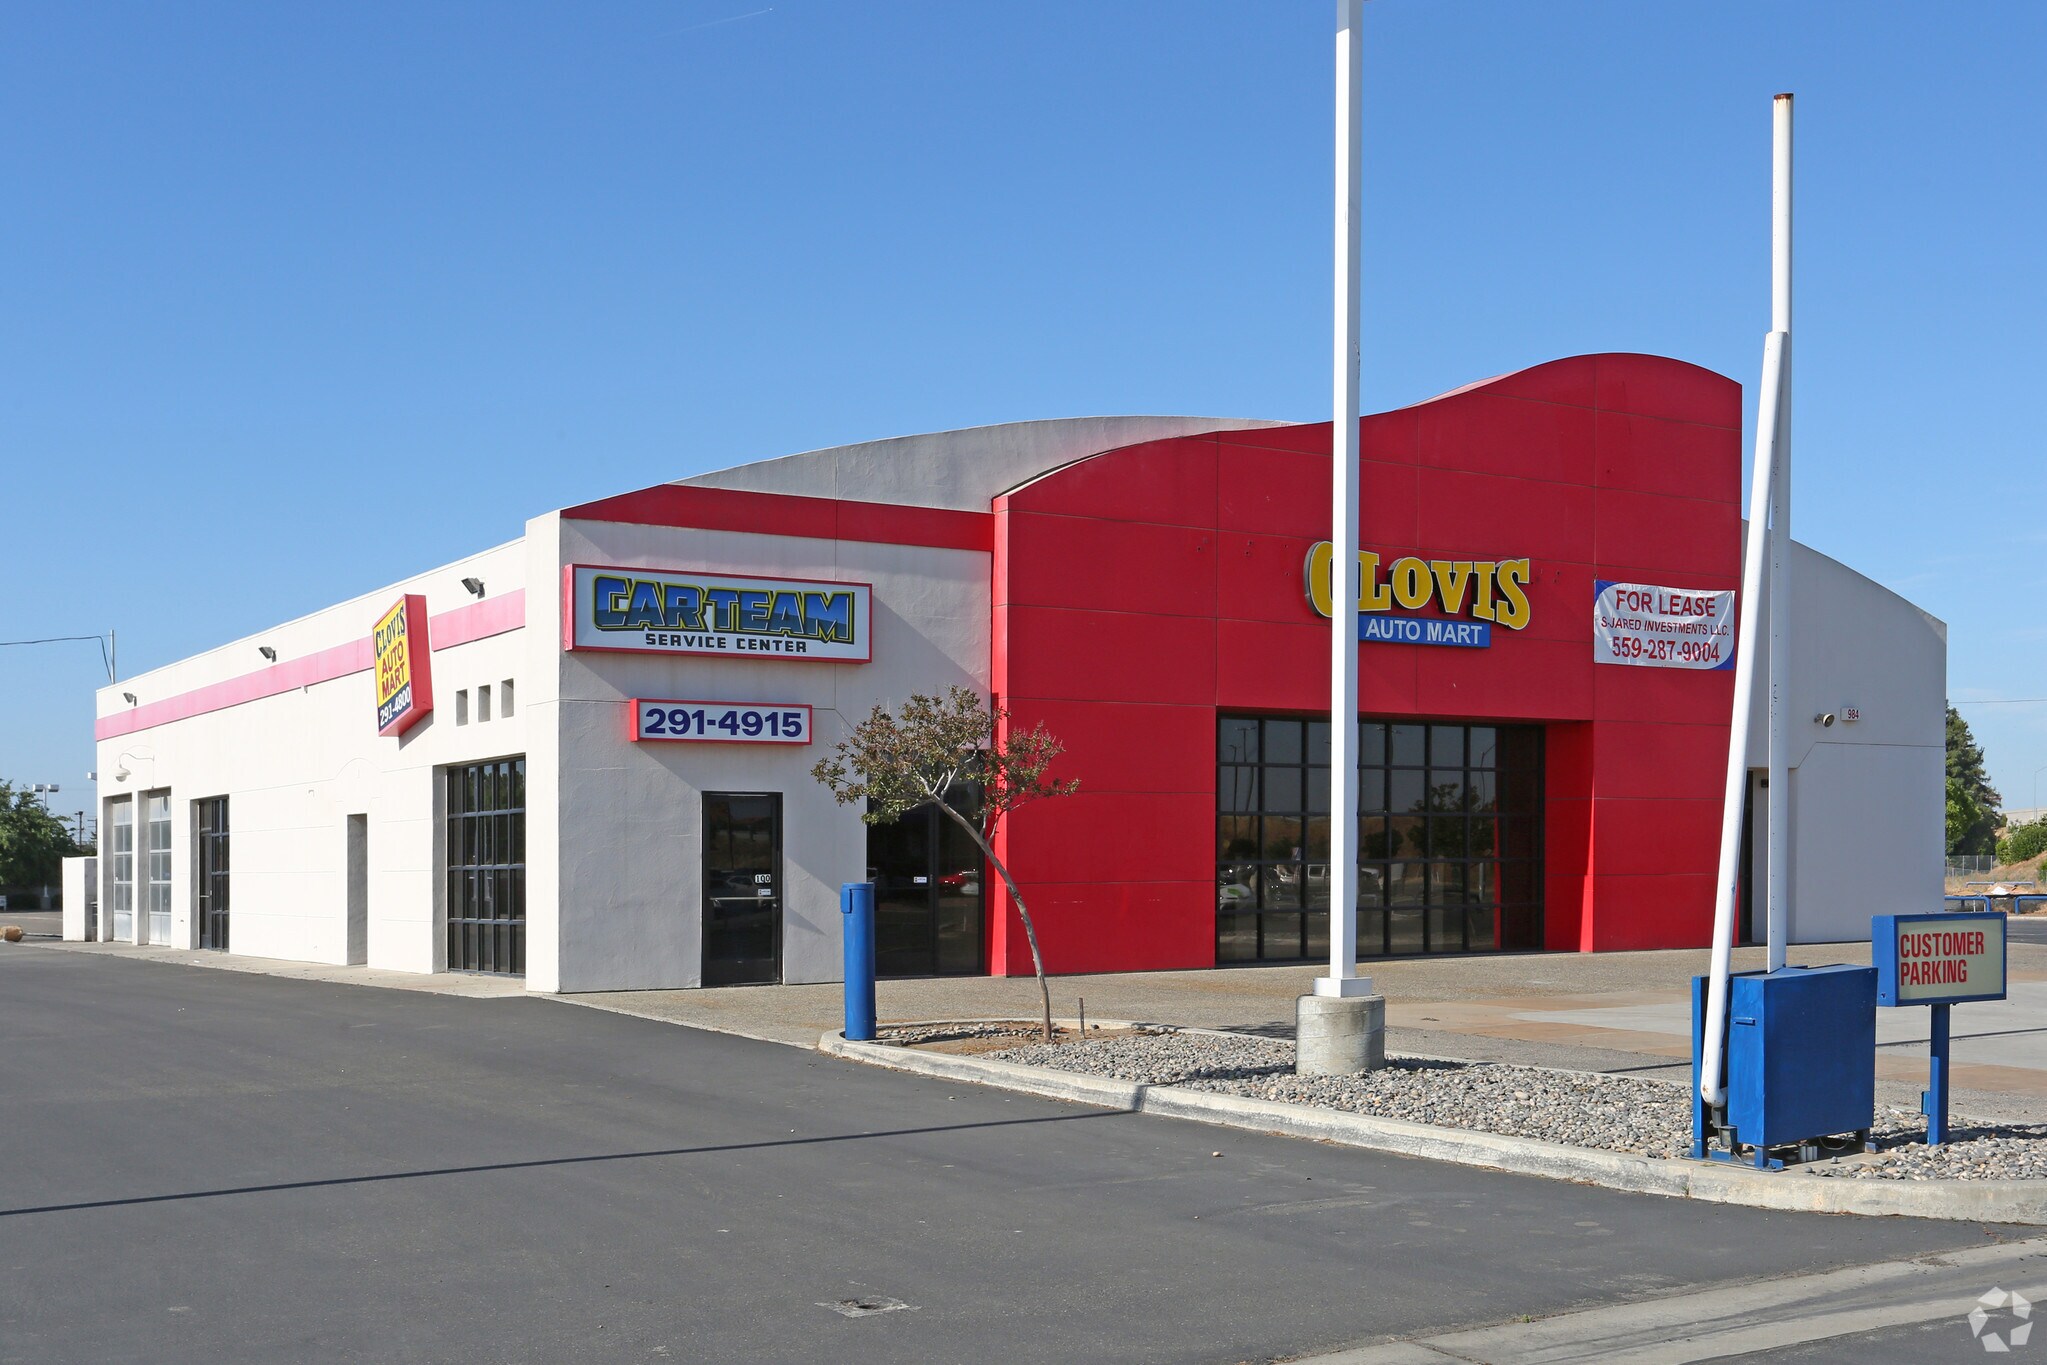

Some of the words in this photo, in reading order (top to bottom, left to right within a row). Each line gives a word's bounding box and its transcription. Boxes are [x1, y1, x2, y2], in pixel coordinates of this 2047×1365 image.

[1615, 589, 1653, 614] FOR
[1659, 595, 1716, 617] LEASE
[376, 604, 406, 660] CLOVIS
[1365, 618, 1421, 641] AUTO
[1426, 622, 1483, 645] MART
[1644, 620, 1708, 635] INVESTMENTS
[645, 633, 727, 649] SERVICE
[736, 637, 807, 653] CENTER
[1612, 636, 1720, 663] 559-287-9004
[381, 640, 404, 680] AUTO
[381, 664, 405, 700] MART
[379, 686, 411, 727] 291-4800
[1848, 709, 1859, 719] 984
[644, 708, 803, 738] 291-4915
[755, 874, 771, 884] 100
[1900, 931, 1985, 959] CUSTOMER
[1900, 959, 1968, 986] PARKING
